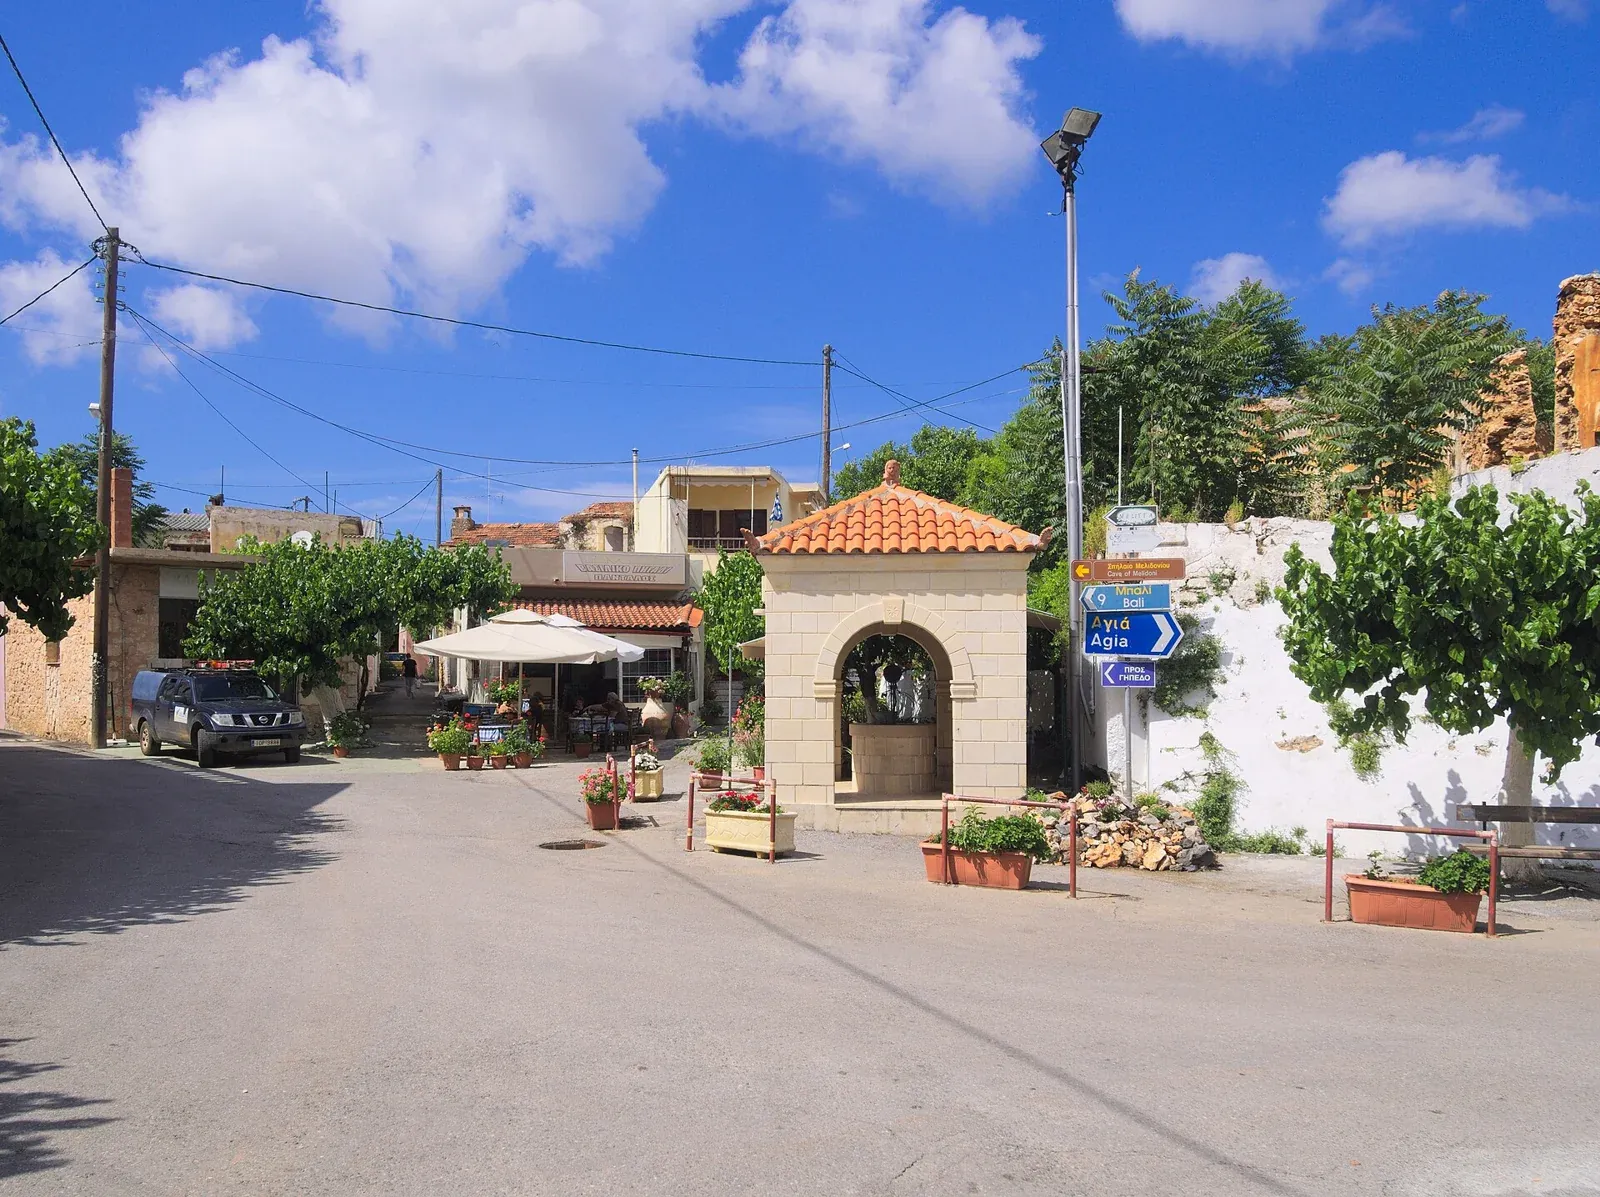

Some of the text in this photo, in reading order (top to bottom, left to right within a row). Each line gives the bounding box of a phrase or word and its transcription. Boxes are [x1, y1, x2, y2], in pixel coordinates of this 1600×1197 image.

[1107, 562, 1171, 571] Σπήλαιο Μελιδονίου
[1097, 594, 1107, 606] 9
[1123, 598, 1145, 608] Bali
[1091, 616, 1130, 632] Αγιά
[1090, 633, 1128, 650] Agia
[1124, 666, 1146, 674] ΠΡΟΣ
